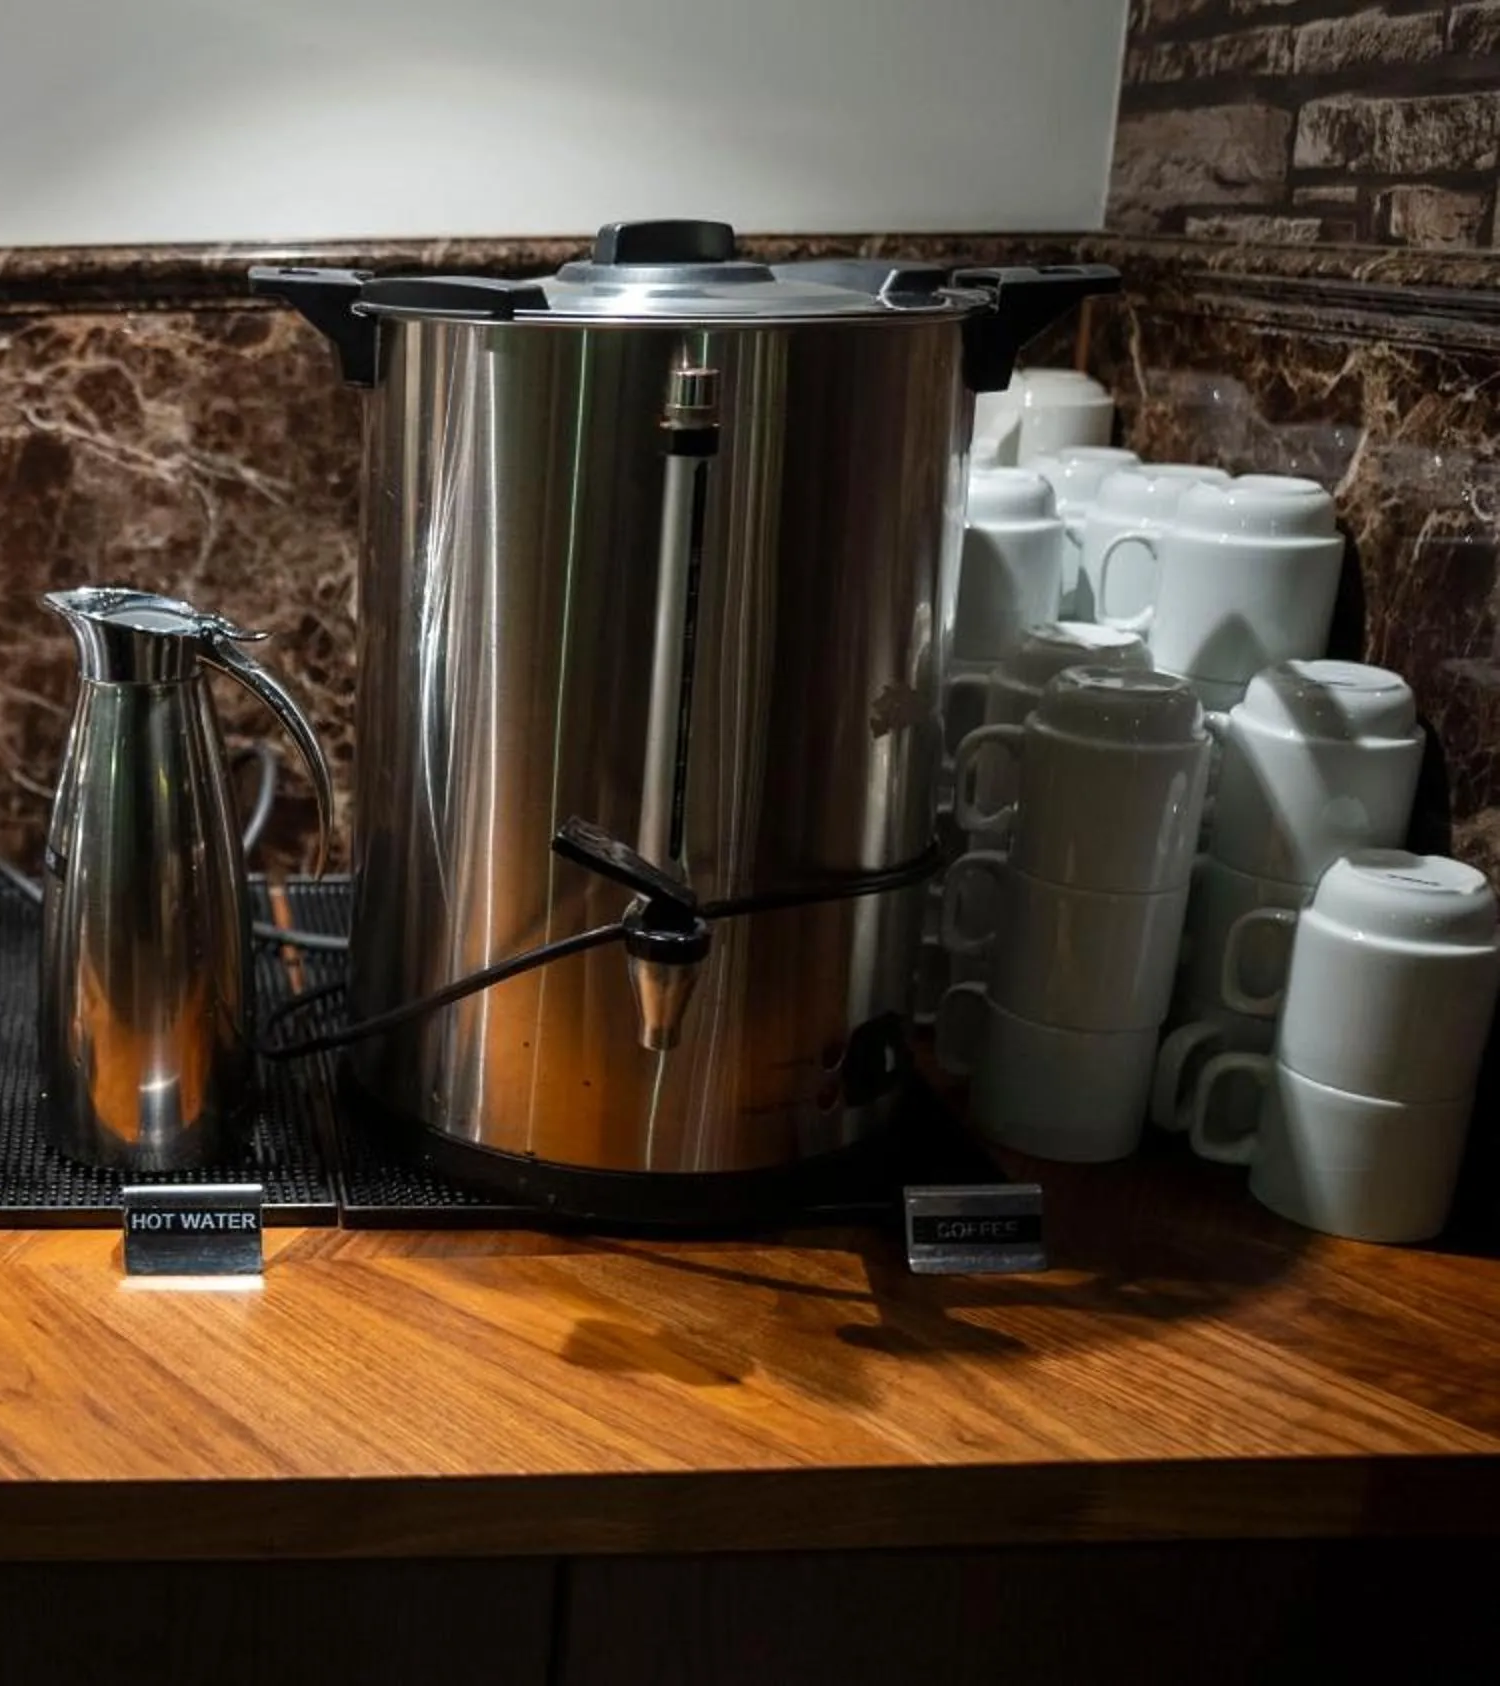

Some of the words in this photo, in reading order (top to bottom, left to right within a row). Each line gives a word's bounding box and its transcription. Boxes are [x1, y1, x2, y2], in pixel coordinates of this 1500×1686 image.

[131, 1213, 176, 1230] HOT
[180, 1213, 257, 1230] WATER
[935, 1219, 1020, 1240] COFFEE
